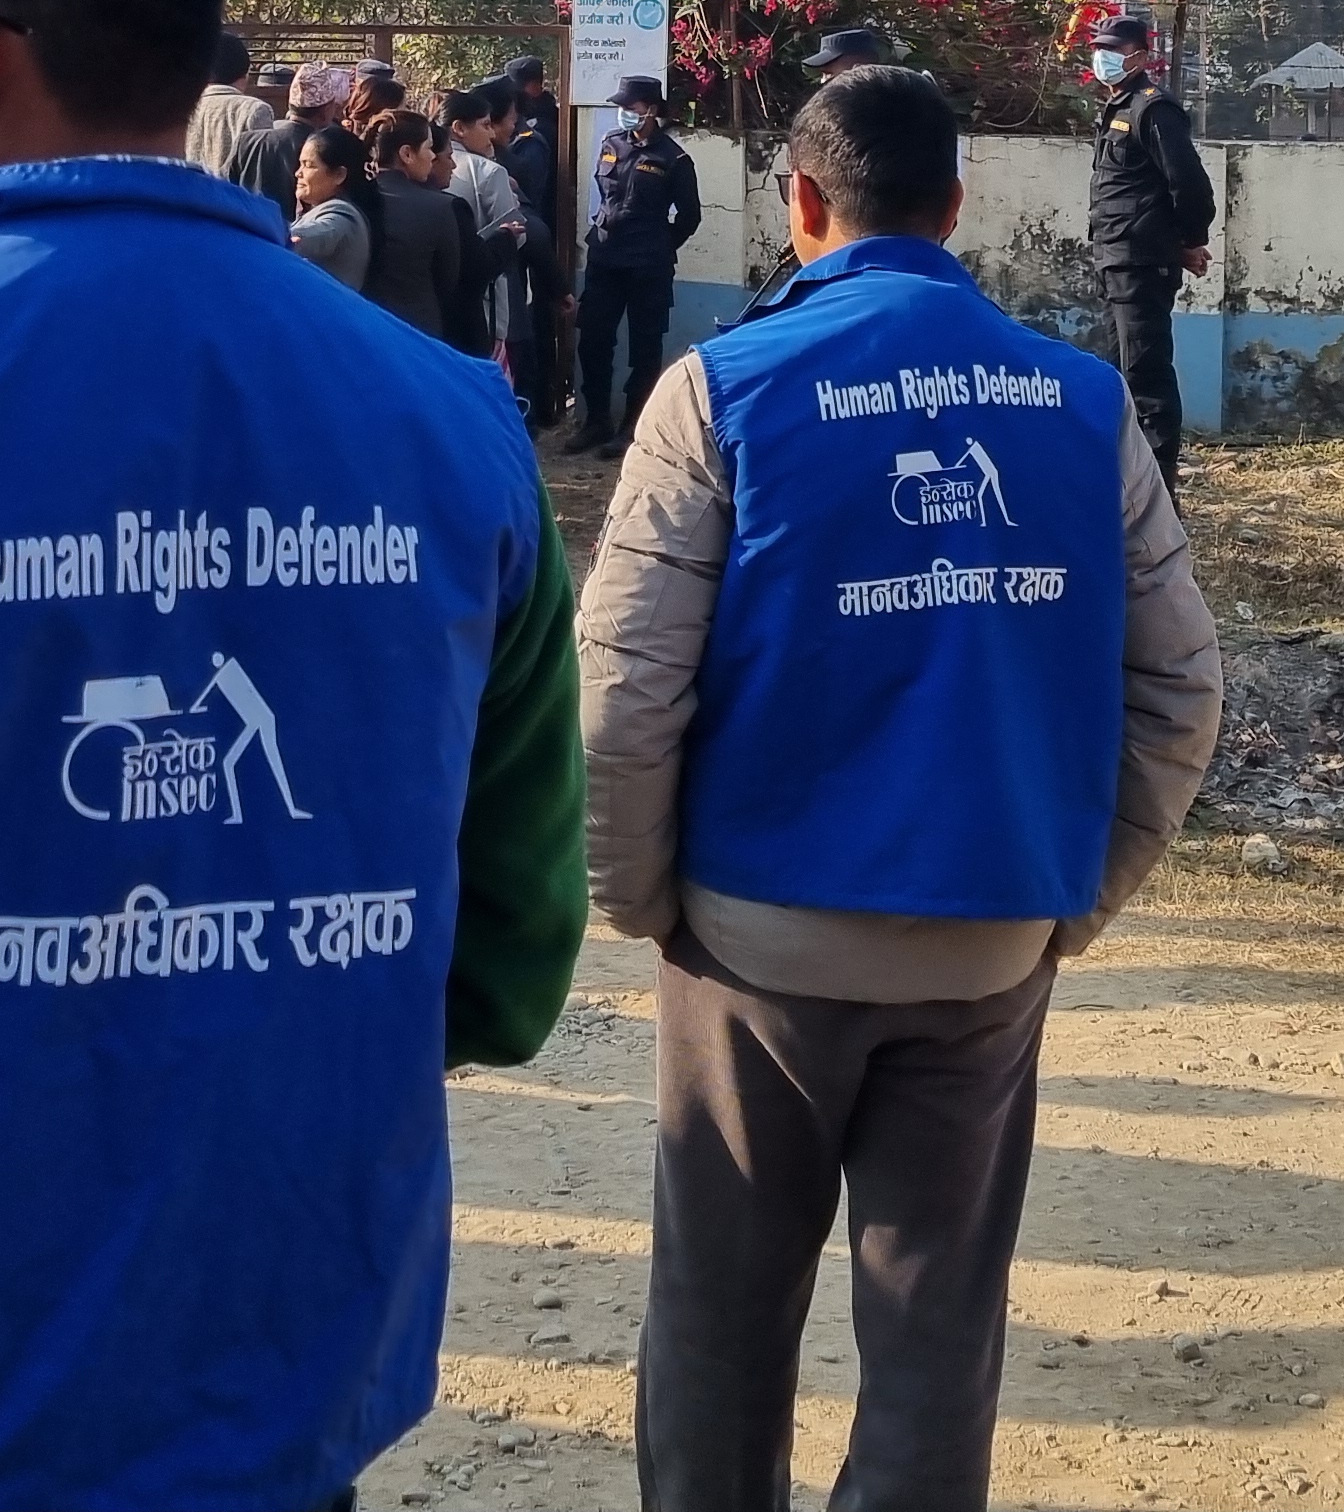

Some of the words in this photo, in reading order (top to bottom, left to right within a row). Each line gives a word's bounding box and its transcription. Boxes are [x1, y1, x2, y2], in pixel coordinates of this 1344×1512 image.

[816, 380, 898, 421] Human
[899, 366, 970, 419] Rights
[972, 364, 1062, 408] Defender
[116, 510, 232, 614] Rights
[246, 505, 419, 587] Defender
[1003, 566, 1068, 607] रक्षक
[288, 887, 417, 971] रक्षक
